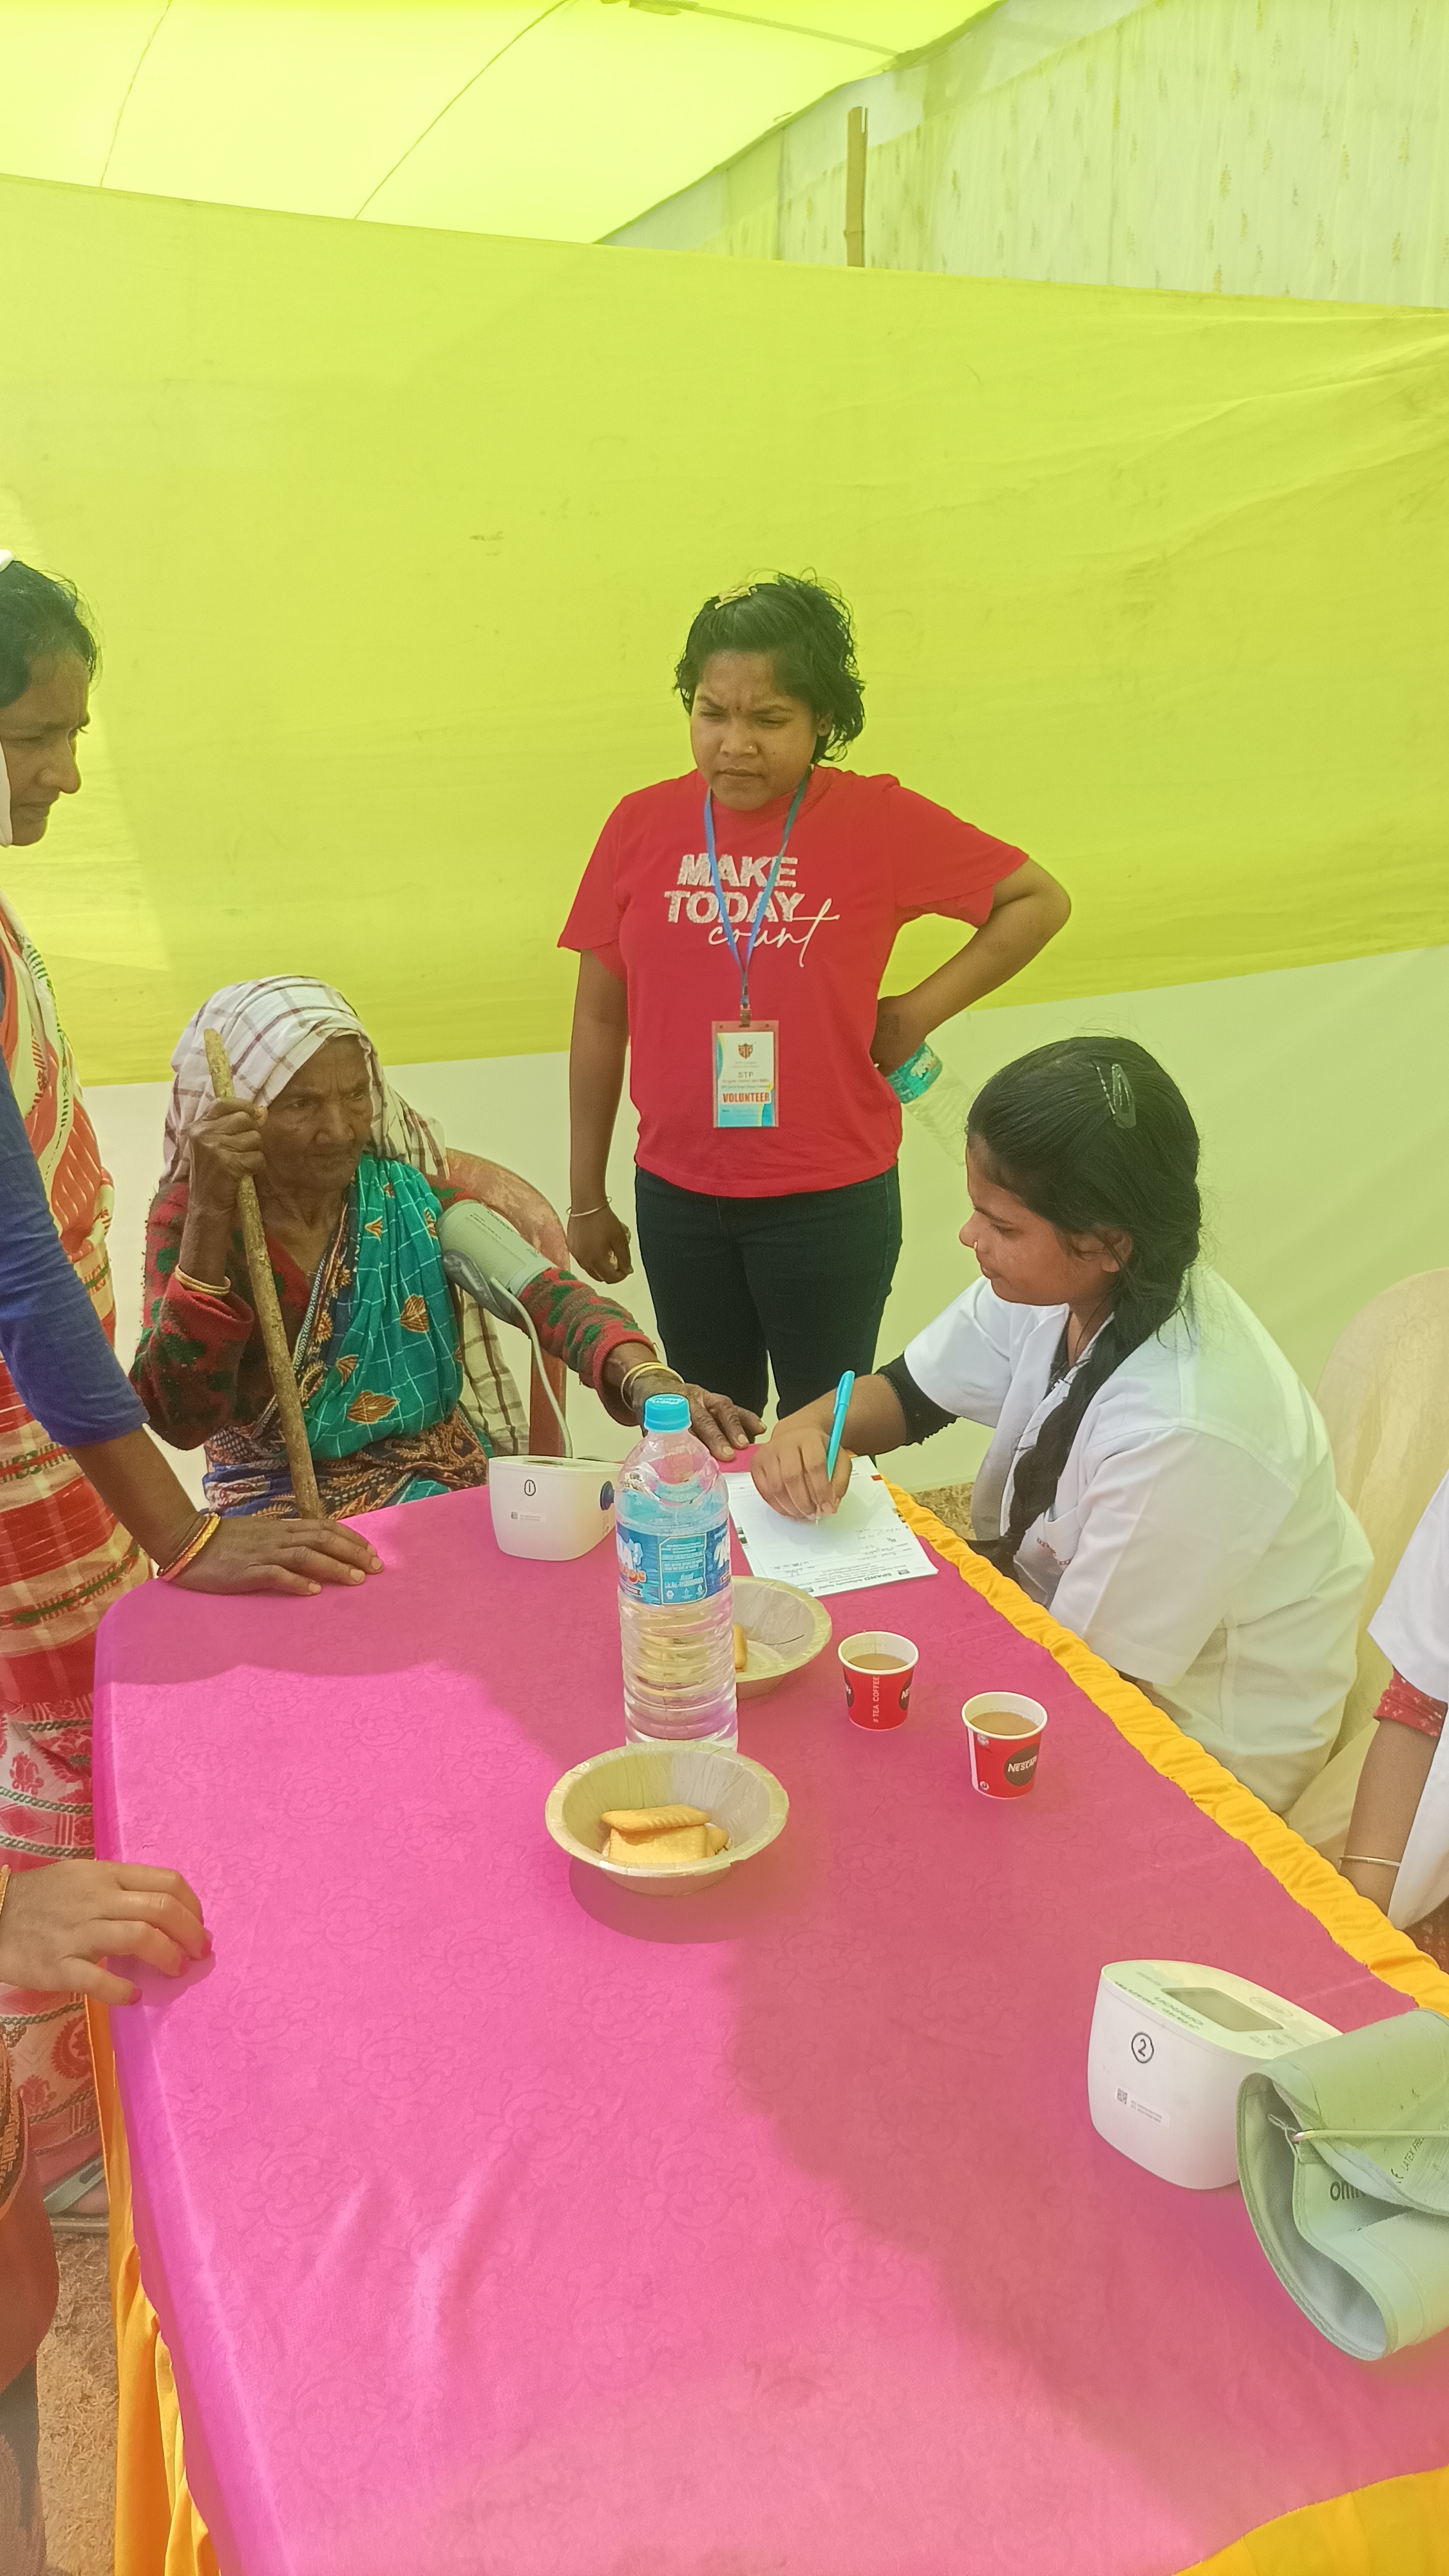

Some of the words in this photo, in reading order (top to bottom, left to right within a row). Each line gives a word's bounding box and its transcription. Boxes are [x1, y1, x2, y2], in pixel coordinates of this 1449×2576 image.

[677, 853, 798, 887] MAKE
[664, 890, 805, 923] TODAY
[708, 898, 840, 967] count
[723, 1092, 770, 1103] VOLUNTEER
[1401, 2148, 1416, 2171] LATEX
